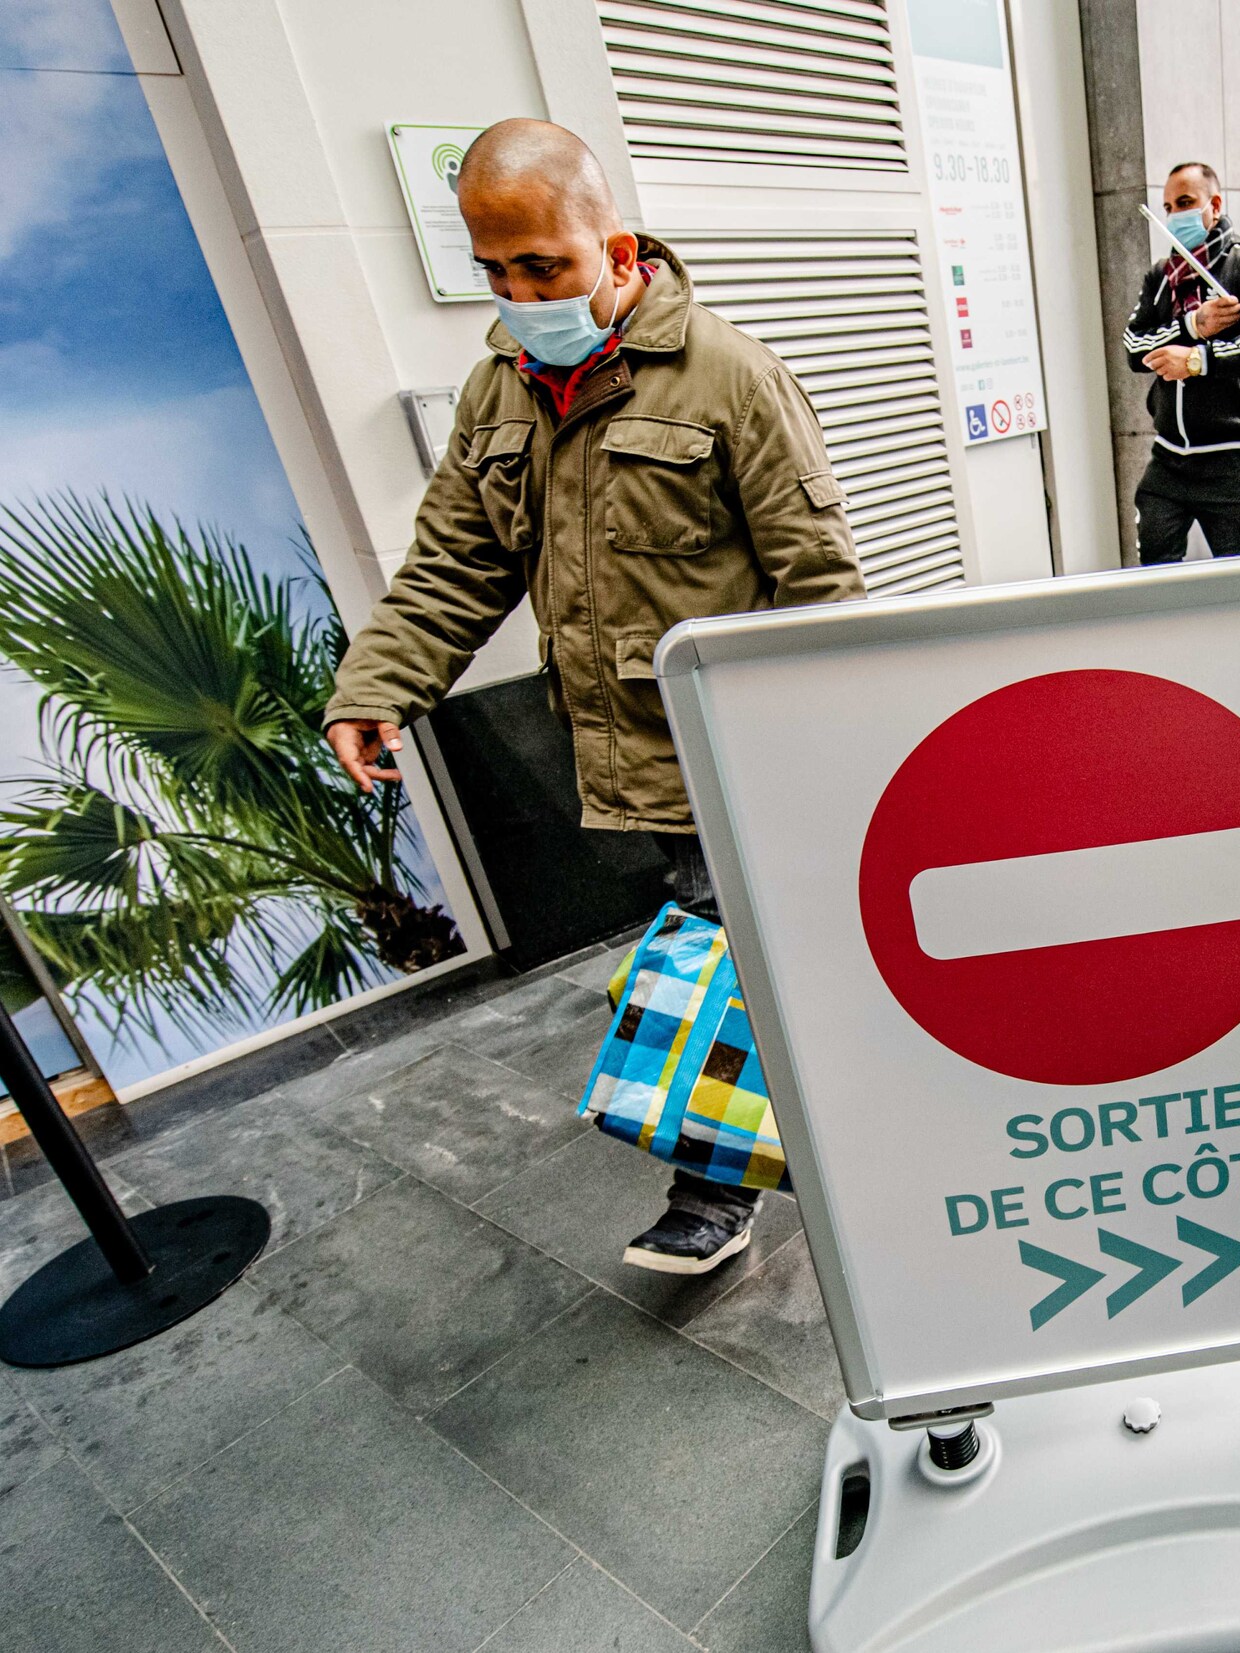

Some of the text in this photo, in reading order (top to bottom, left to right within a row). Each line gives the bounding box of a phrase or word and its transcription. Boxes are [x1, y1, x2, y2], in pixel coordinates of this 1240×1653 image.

[933, 152, 1010, 184] 9.30-18.30
[944, 1186, 1030, 1237] DE
[1044, 1171, 1127, 1220] CE
